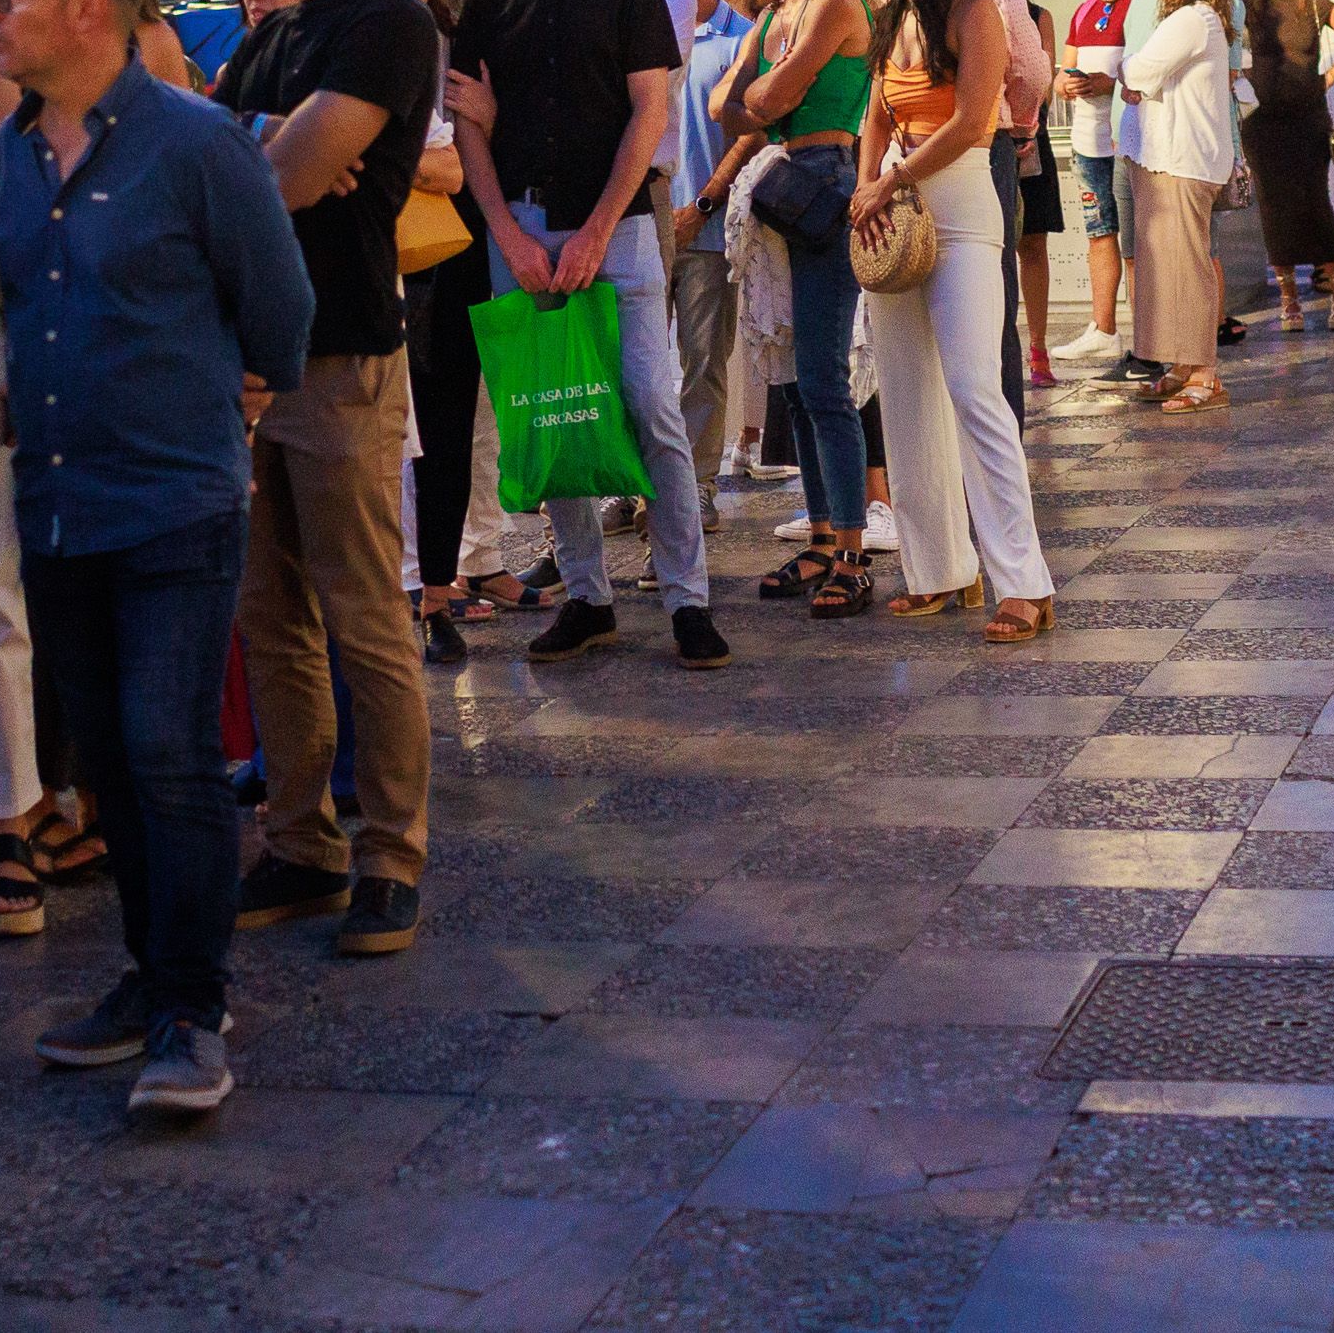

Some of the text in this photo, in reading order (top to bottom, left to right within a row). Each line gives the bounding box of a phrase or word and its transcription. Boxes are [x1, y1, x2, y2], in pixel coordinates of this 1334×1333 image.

[510, 380, 611, 407] LA CASA DE LAS
[532, 407, 599, 428] CARCASAS
